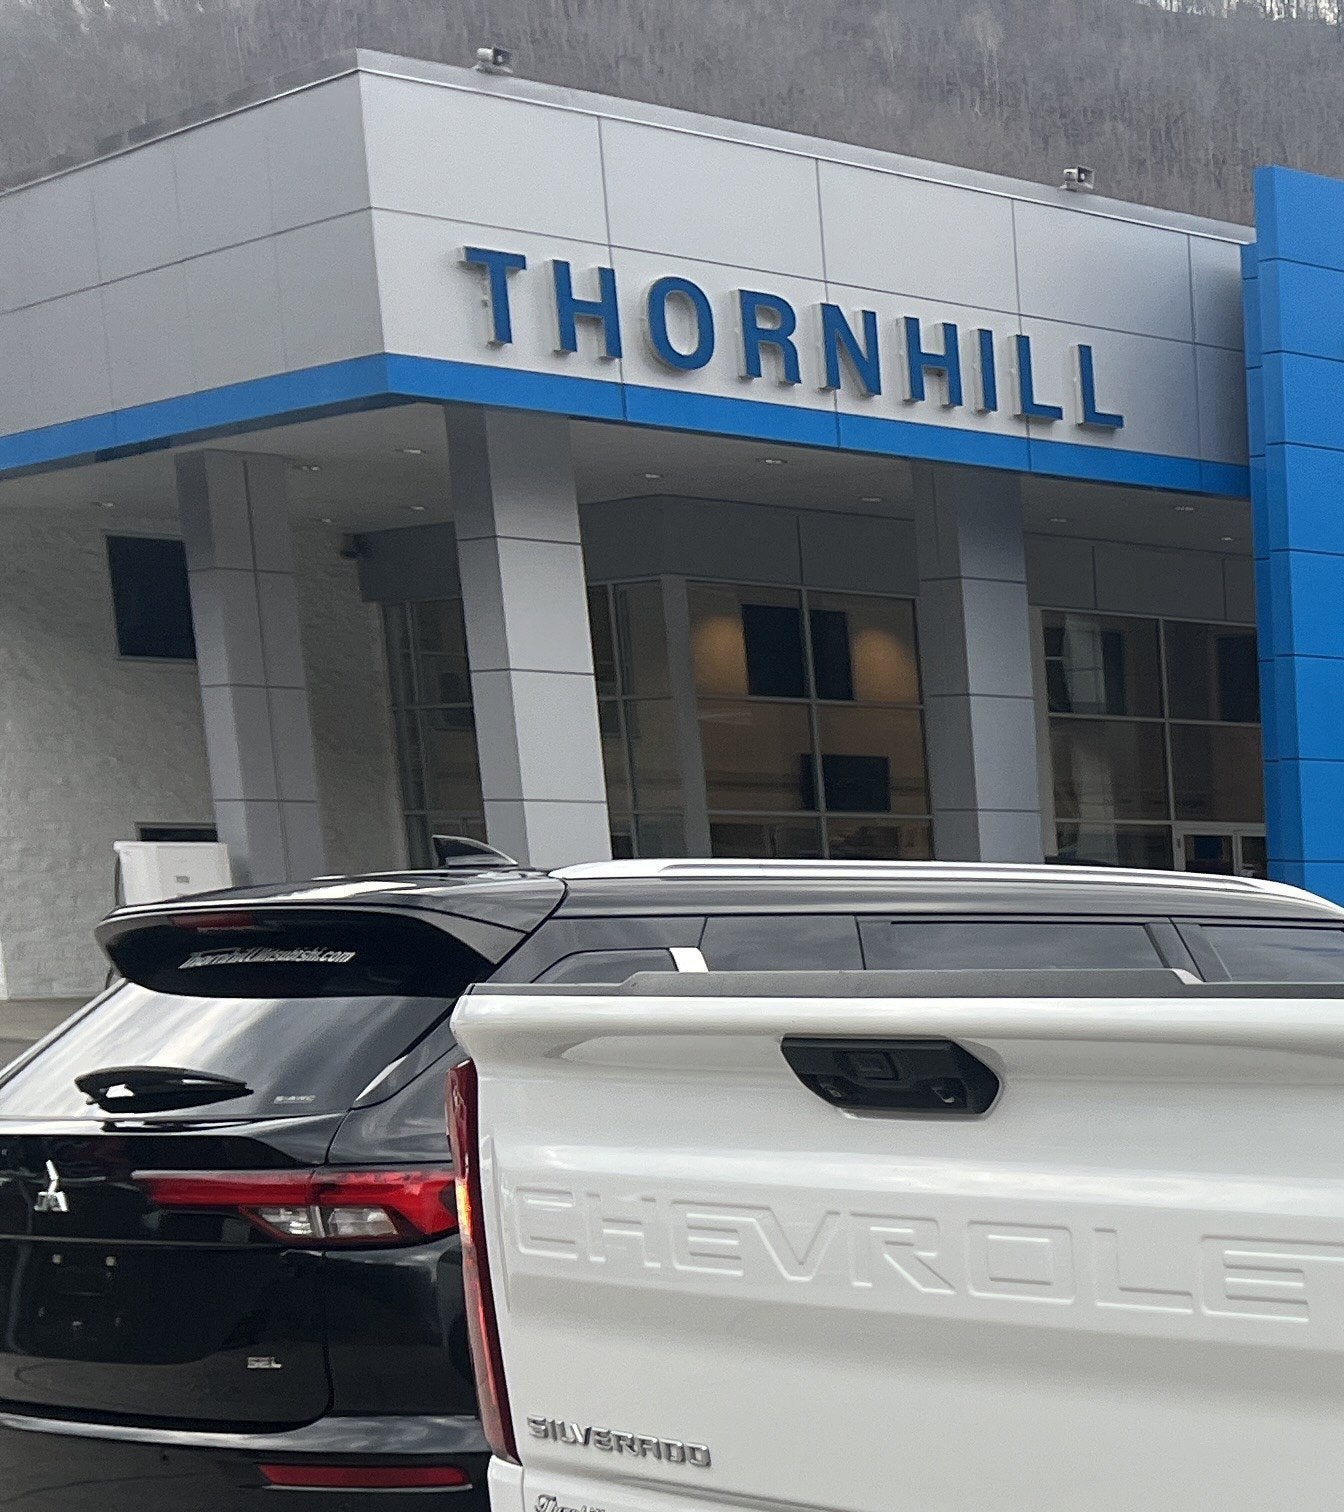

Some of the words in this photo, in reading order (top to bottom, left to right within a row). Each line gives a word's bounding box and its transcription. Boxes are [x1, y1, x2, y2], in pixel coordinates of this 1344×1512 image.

[459, 245, 1124, 429] THORNHILL
[247, 1356, 282, 1369] SEL
[526, 1414, 711, 1468] SILVERADO
